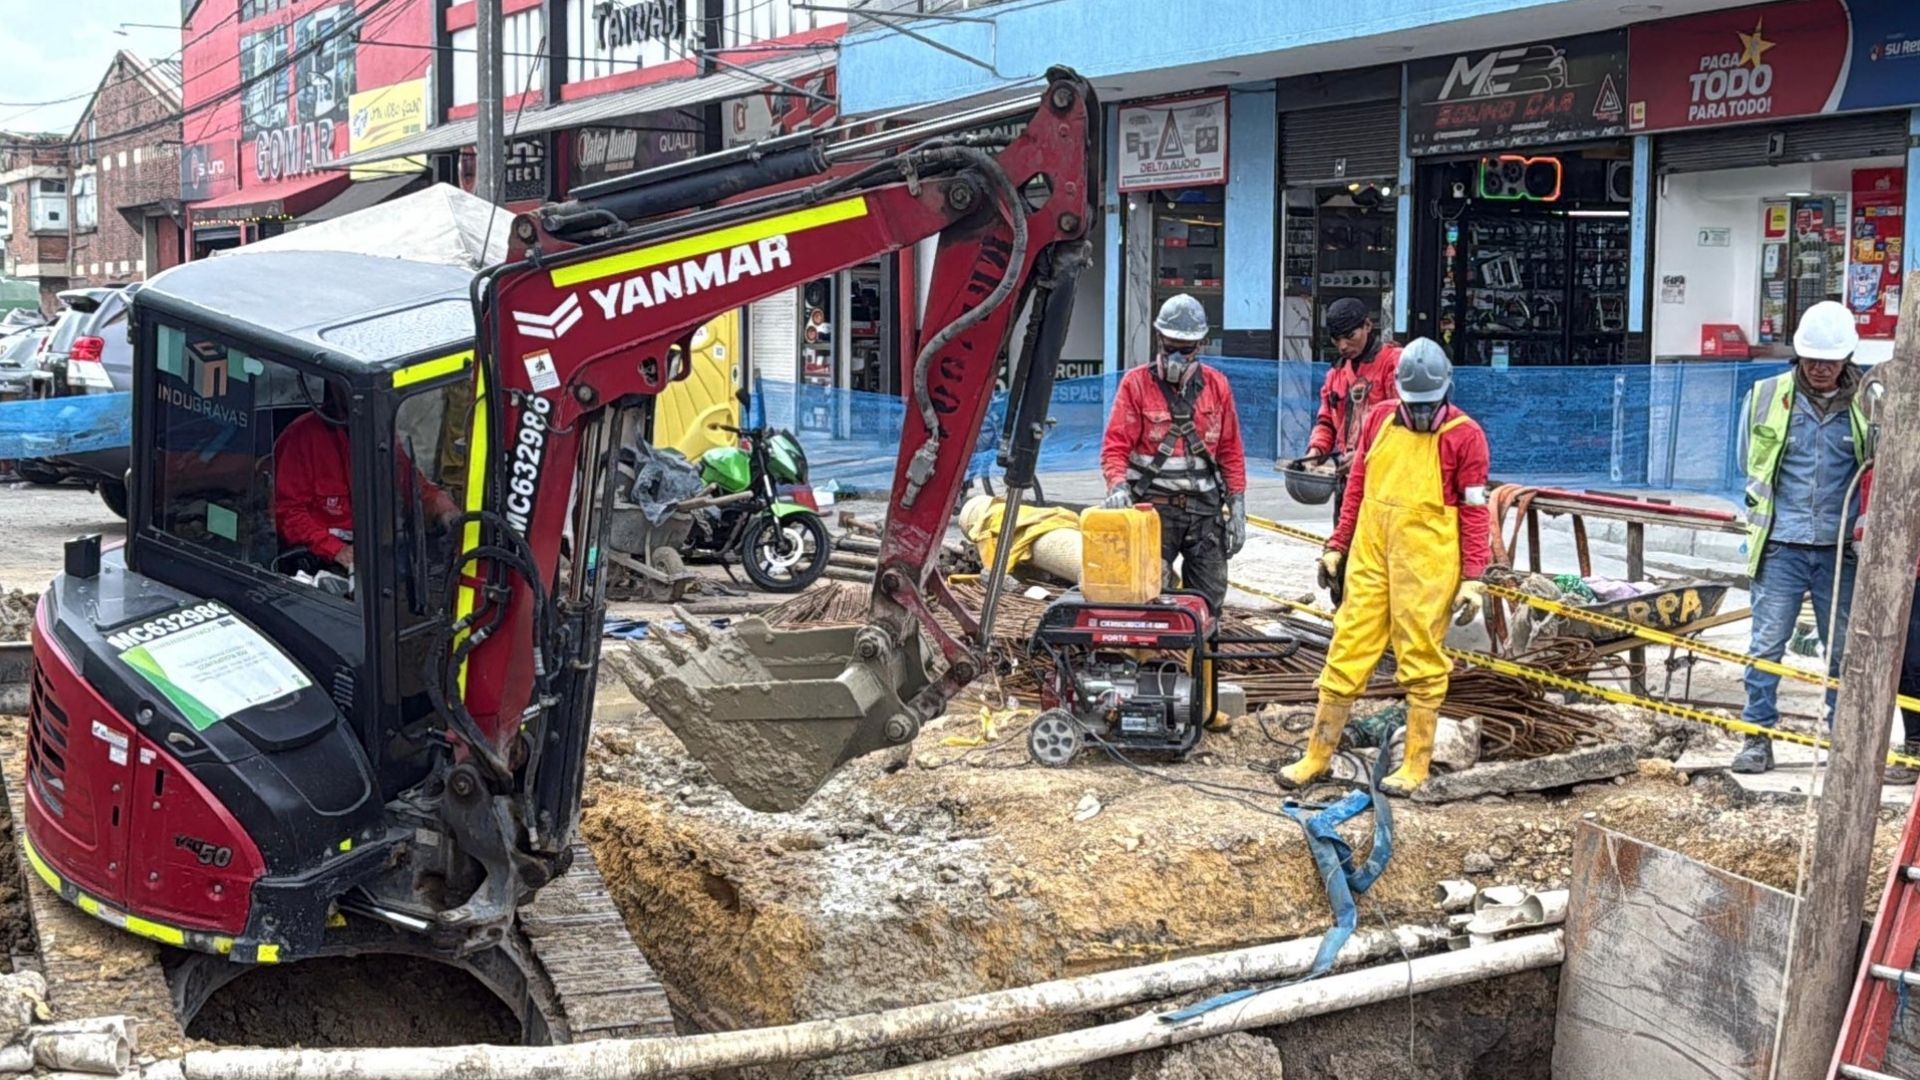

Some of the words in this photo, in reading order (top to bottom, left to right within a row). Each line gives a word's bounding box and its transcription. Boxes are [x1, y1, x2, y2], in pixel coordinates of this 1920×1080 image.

[1689, 64, 1773, 102] TODO
[1700, 52, 1740, 71] PAGA
[1688, 102, 1727, 121] PARA
[1728, 96, 1773, 116] TODO!
[256, 118, 334, 180] GOMAR
[589, 234, 792, 320] YANMAR
[157, 383, 248, 428] INDUGRAVAS
[506, 394, 551, 538] MC632986
